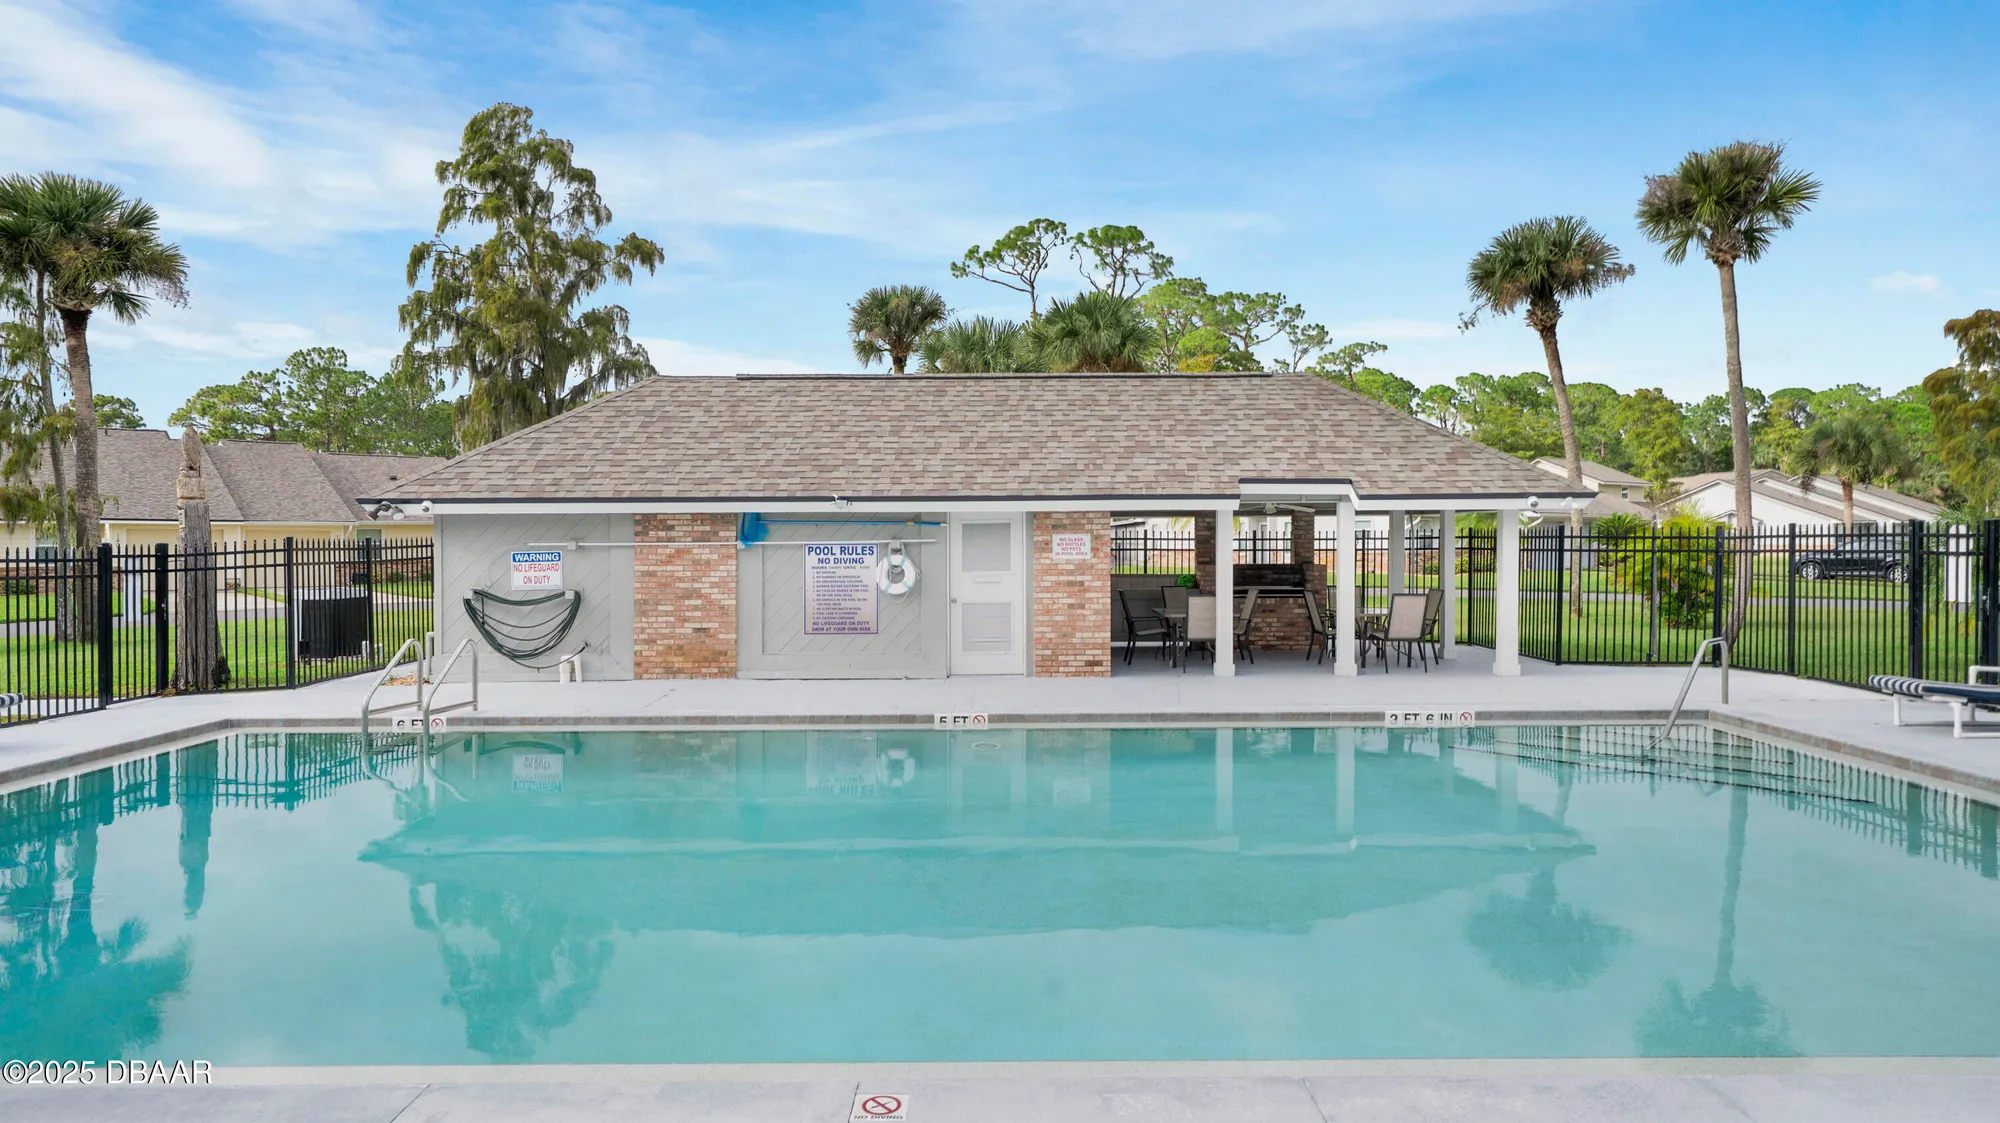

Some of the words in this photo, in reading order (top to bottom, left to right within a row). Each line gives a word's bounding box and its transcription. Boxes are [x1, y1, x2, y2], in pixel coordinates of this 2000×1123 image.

[808, 546, 836, 556] POOL
[840, 546, 874, 556] RULES
[514, 553, 559, 561] WARNING
[514, 563, 522, 572] NO
[524, 563, 559, 572] LIFEGUARD
[523, 576, 532, 584] ON
[534, 576, 550, 584] DUTY
[954, 716, 968, 724] FT
[1404, 713, 1419, 722] FT
[1441, 713, 1452, 722] IN
